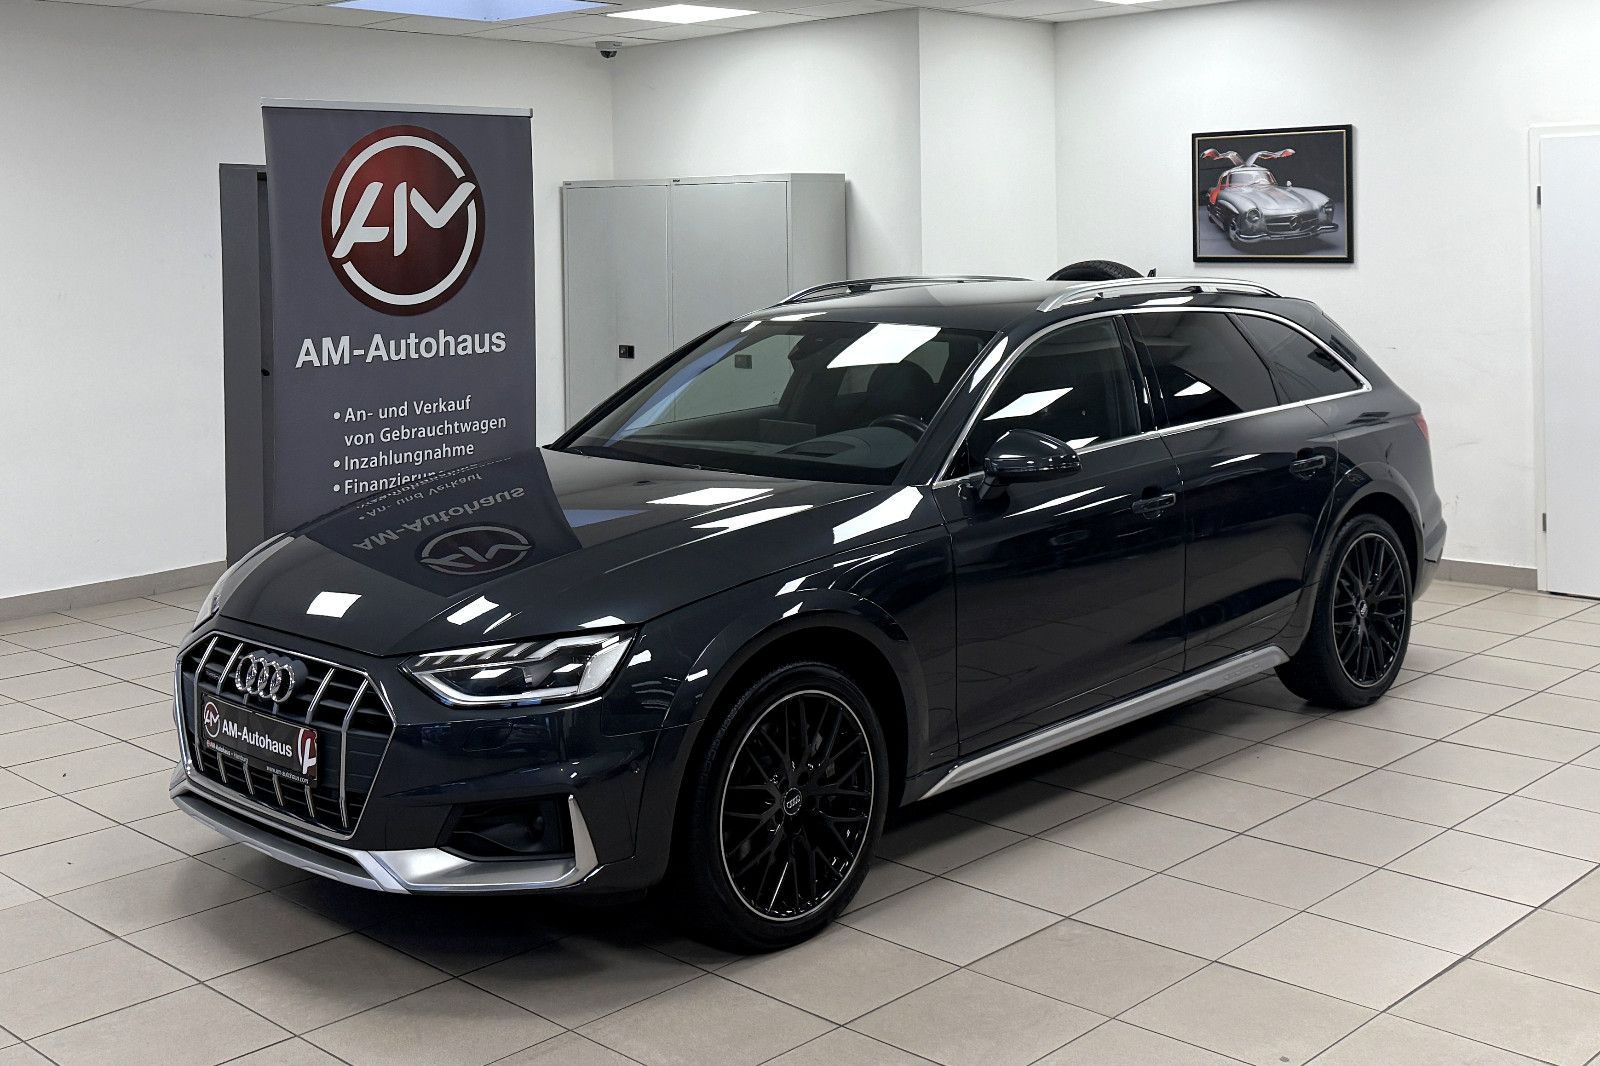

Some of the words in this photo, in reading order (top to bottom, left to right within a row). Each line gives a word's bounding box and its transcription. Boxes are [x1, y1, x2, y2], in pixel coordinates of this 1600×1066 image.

[295, 329, 507, 368] AM-Autohaus
[344, 407, 373, 422] An-
[379, 401, 408, 419] und
[413, 394, 472, 415] Verkauf
[344, 430, 374, 446] von
[380, 416, 507, 442] Gebrauchtwagen
[344, 442, 475, 471] Inzahlungnahme
[222, 719, 293, 757] AM-Autohaus
